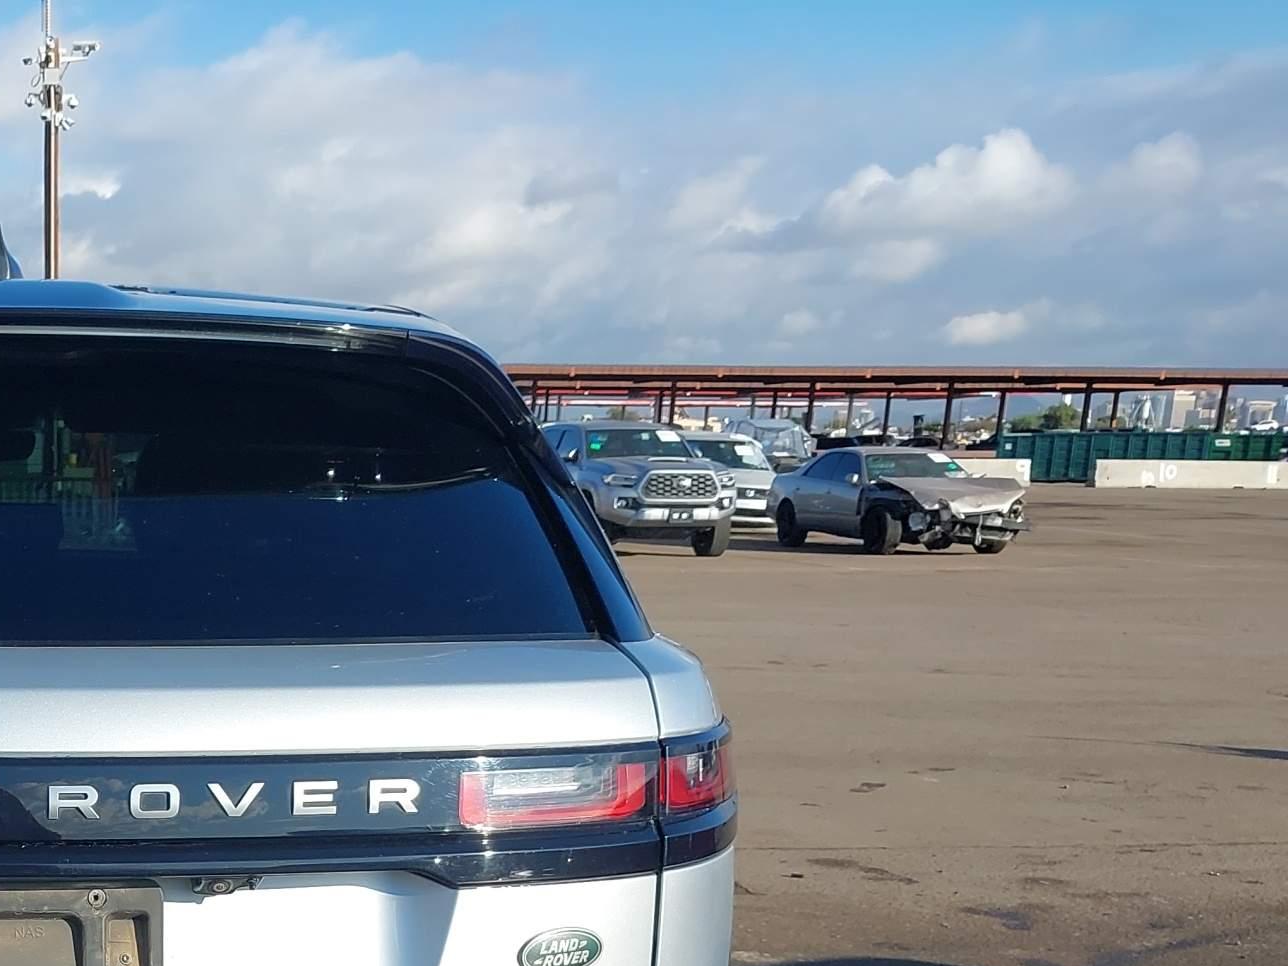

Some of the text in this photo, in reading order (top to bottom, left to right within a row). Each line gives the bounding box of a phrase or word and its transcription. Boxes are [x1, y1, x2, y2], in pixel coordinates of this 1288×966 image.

[1158, 463, 1178, 483] 10
[47, 778, 421, 820] ROVER
[13, 926, 46, 939] NAS
[539, 938, 579, 955] LAND
